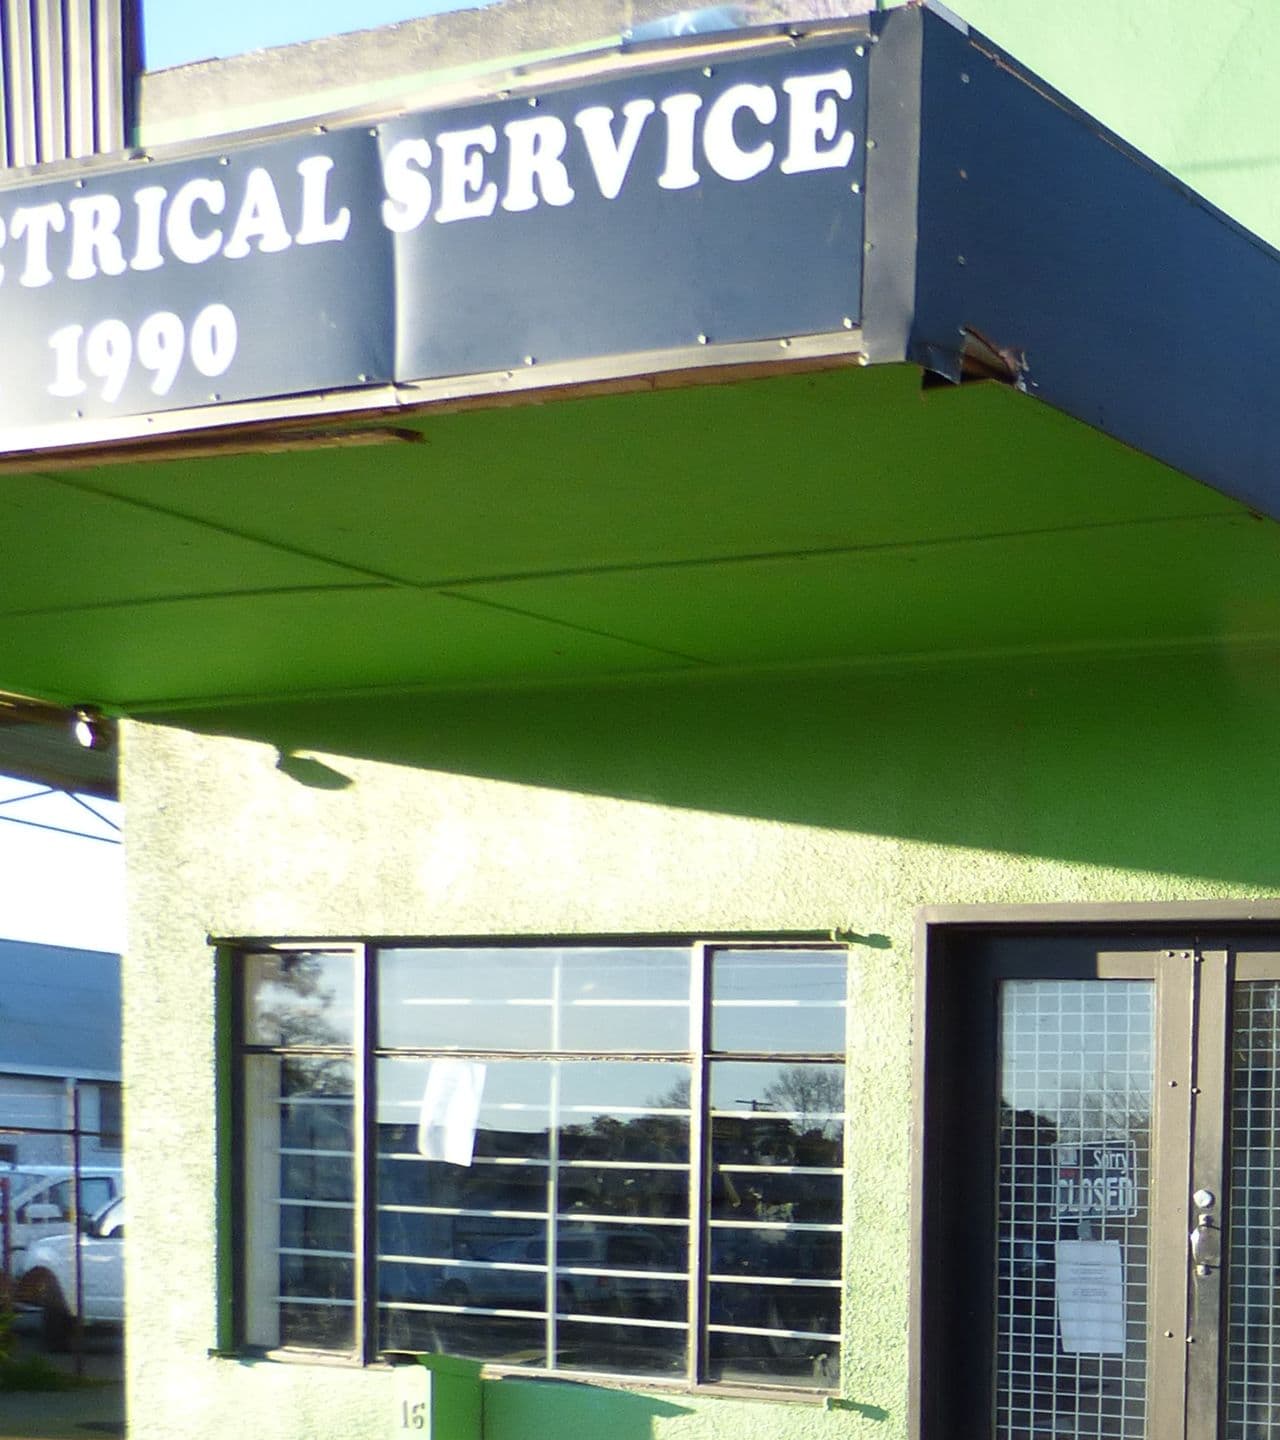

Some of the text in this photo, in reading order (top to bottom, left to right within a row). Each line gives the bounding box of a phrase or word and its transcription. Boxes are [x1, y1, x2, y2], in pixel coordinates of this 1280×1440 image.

[0, 70, 855, 289] TRICAL SERVICE
[47, 303, 238, 402] 1990
[1057, 1177, 1133, 1211] CLOSED
